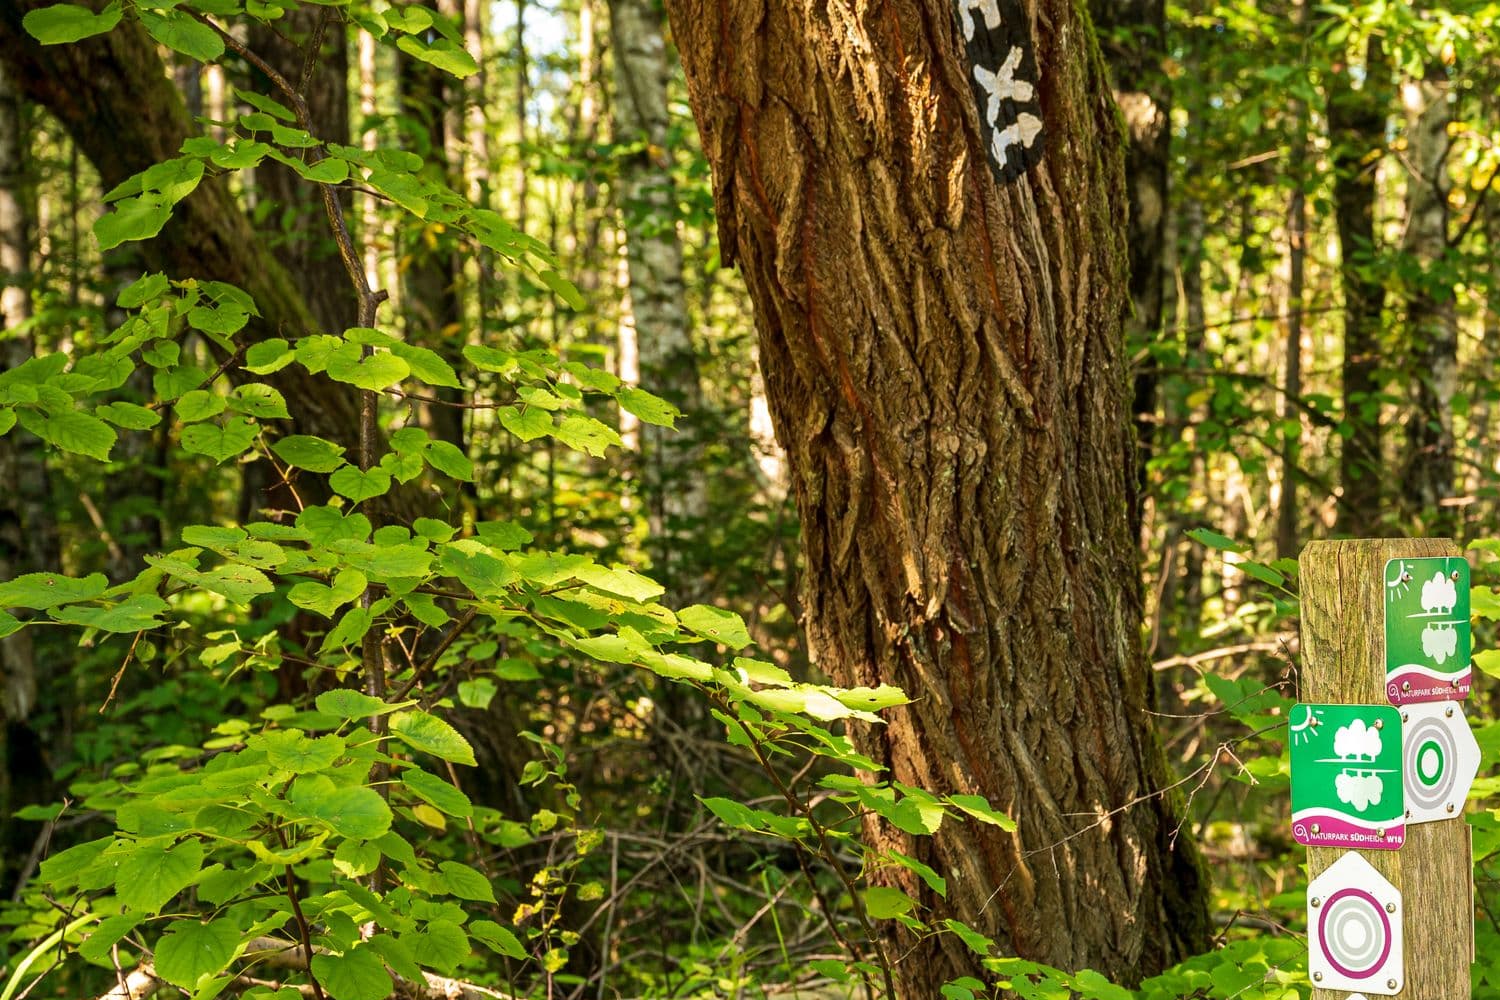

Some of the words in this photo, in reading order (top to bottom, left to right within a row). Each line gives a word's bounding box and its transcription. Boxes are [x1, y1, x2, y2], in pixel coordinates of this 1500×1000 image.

[1401, 689, 1431, 698] NATURPARK
[1310, 832, 1349, 841] NATURPARK
[1350, 832, 1384, 843] SÜDHEIDE
[1387, 835, 1402, 844] W18
